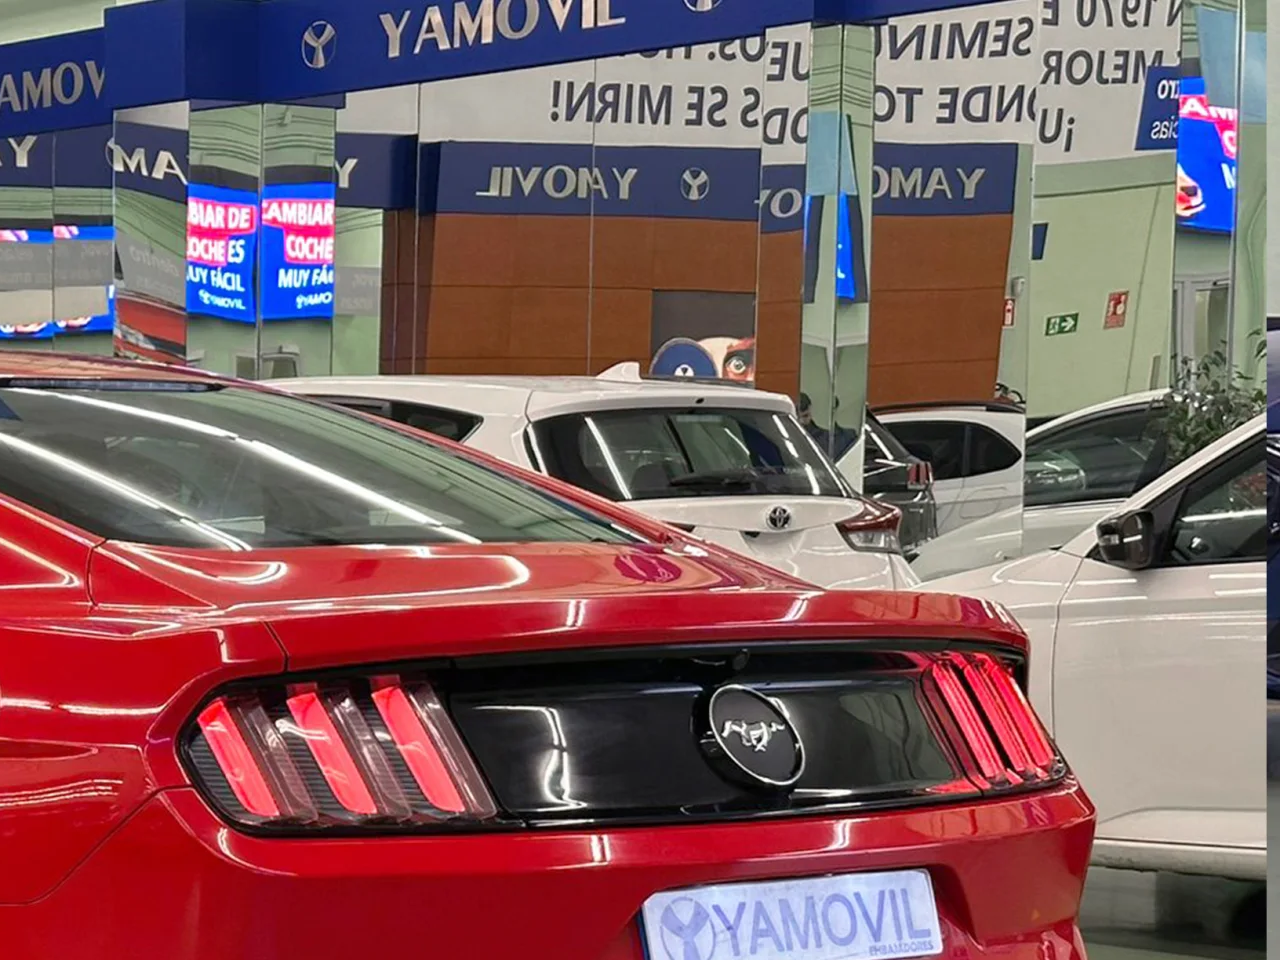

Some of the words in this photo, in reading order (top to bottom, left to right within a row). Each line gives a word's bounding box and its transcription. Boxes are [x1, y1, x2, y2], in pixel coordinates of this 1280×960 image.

[378, 0, 627, 58] YAMOVIL
[228, 206, 251, 229] DE
[285, 235, 335, 261] COCHE
[277, 268, 310, 290] MUY
[712, 888, 932, 957] YAMOVIL
